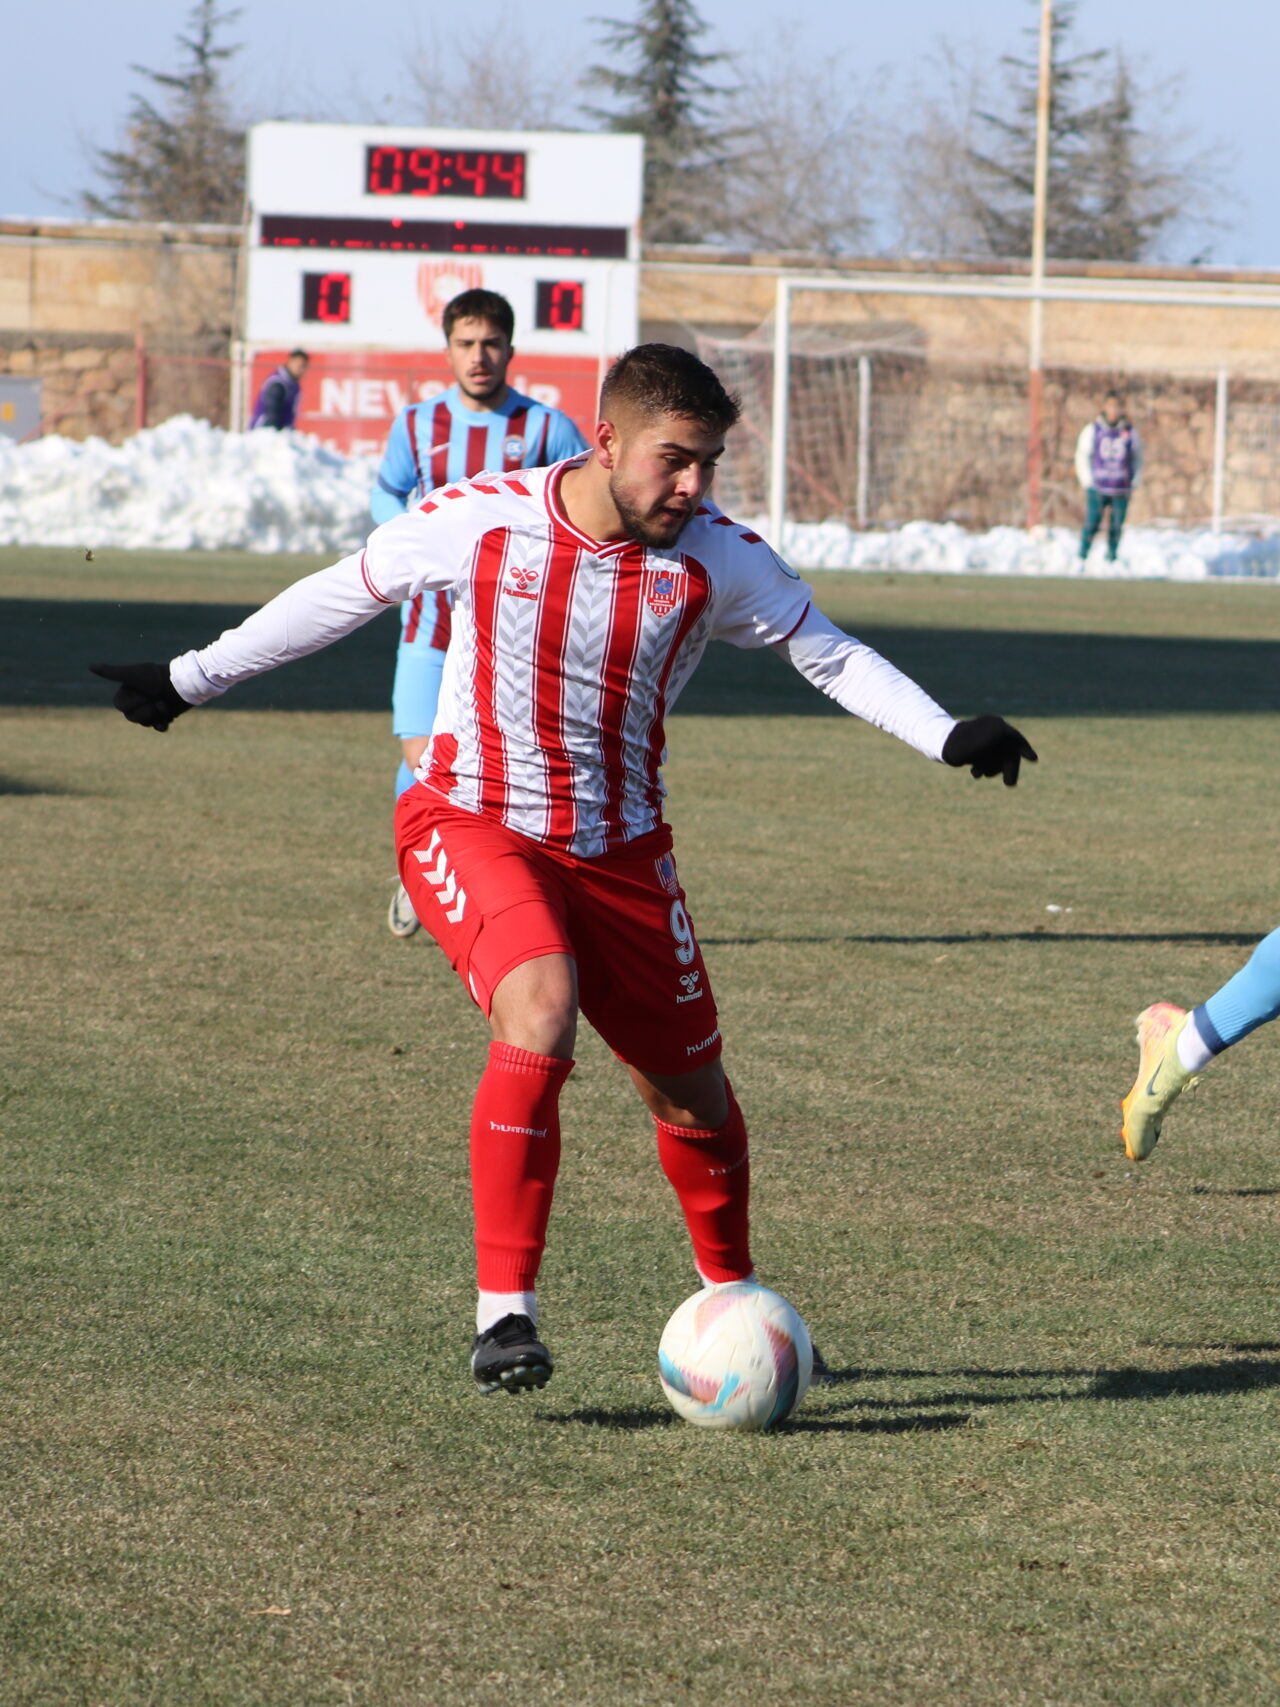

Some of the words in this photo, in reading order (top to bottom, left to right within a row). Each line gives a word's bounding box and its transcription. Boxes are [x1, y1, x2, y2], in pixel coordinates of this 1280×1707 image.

[369, 146, 524, 198] 09:44
[317, 272, 351, 323] 0
[549, 281, 583, 331] 0
[503, 586, 538, 600] hummel
[670, 899, 695, 965] 9
[676, 988, 703, 1004] hummel
[489, 1121, 548, 1138] hummel
